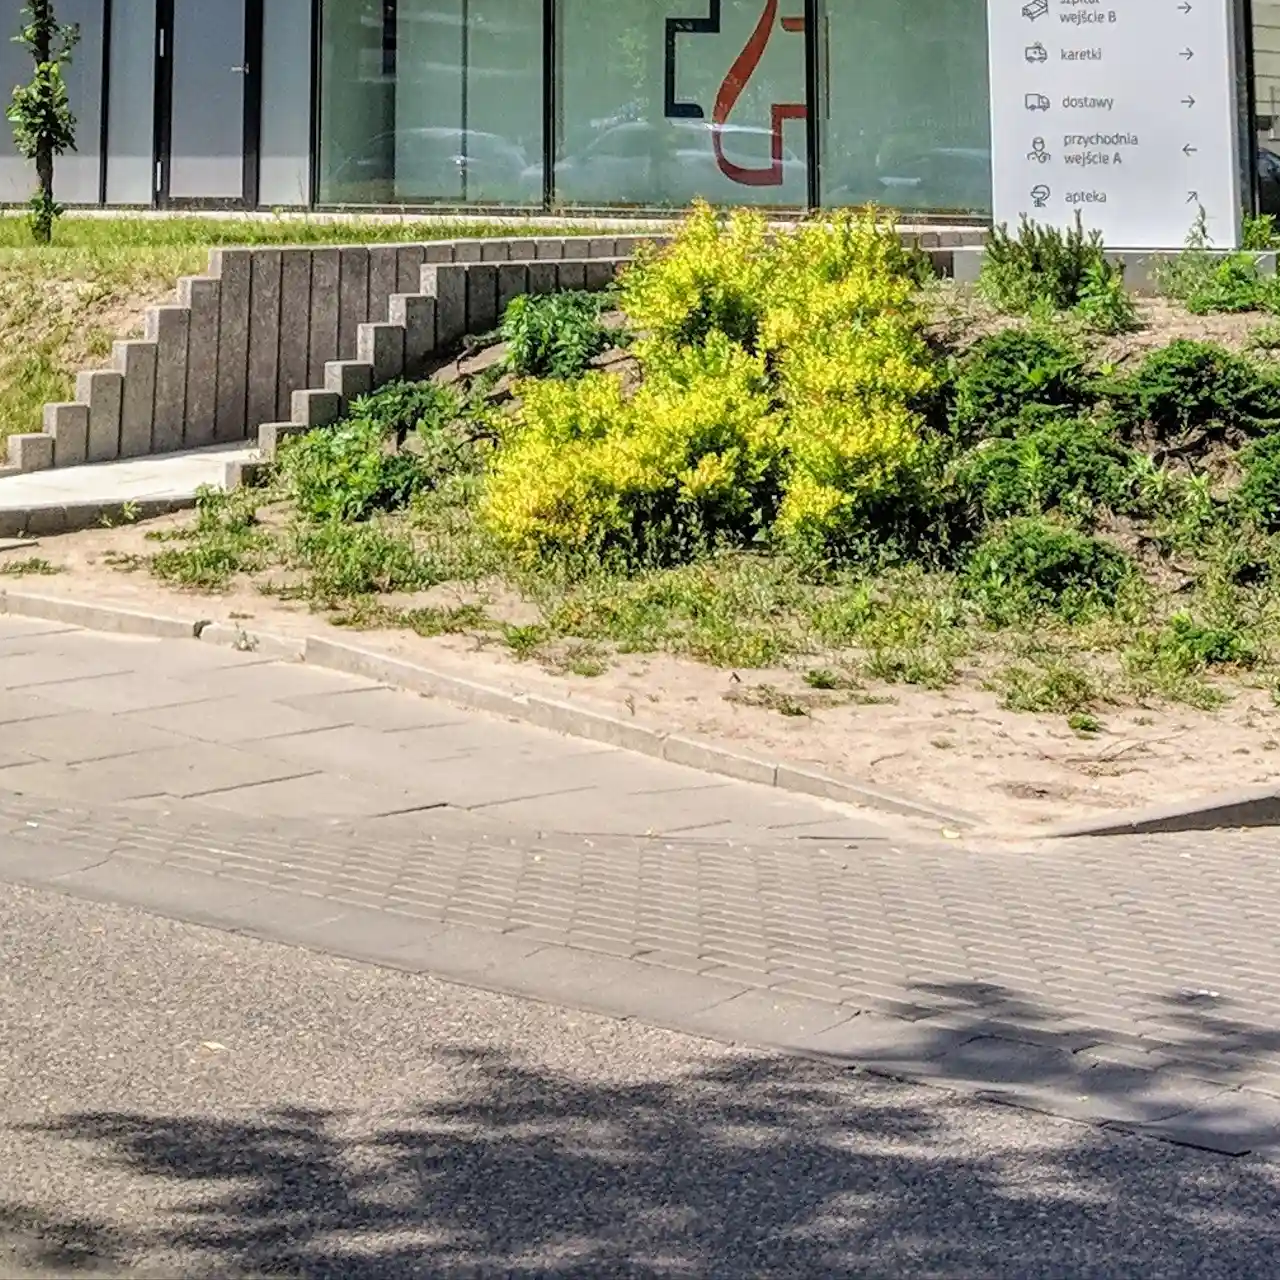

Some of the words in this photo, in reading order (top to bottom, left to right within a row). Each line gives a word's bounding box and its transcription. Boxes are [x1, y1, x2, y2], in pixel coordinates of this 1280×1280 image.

[1060, 10, 1105, 26] wejście
[1108, 11, 1117, 23] B
[1060, 48, 1102, 61] karetki
[1062, 95, 1114, 111] dostawy
[1064, 133, 1138, 148] przychodnia
[1064, 151, 1110, 167] wejście
[1112, 152, 1122, 165] A
[1065, 190, 1107, 204] apteka
